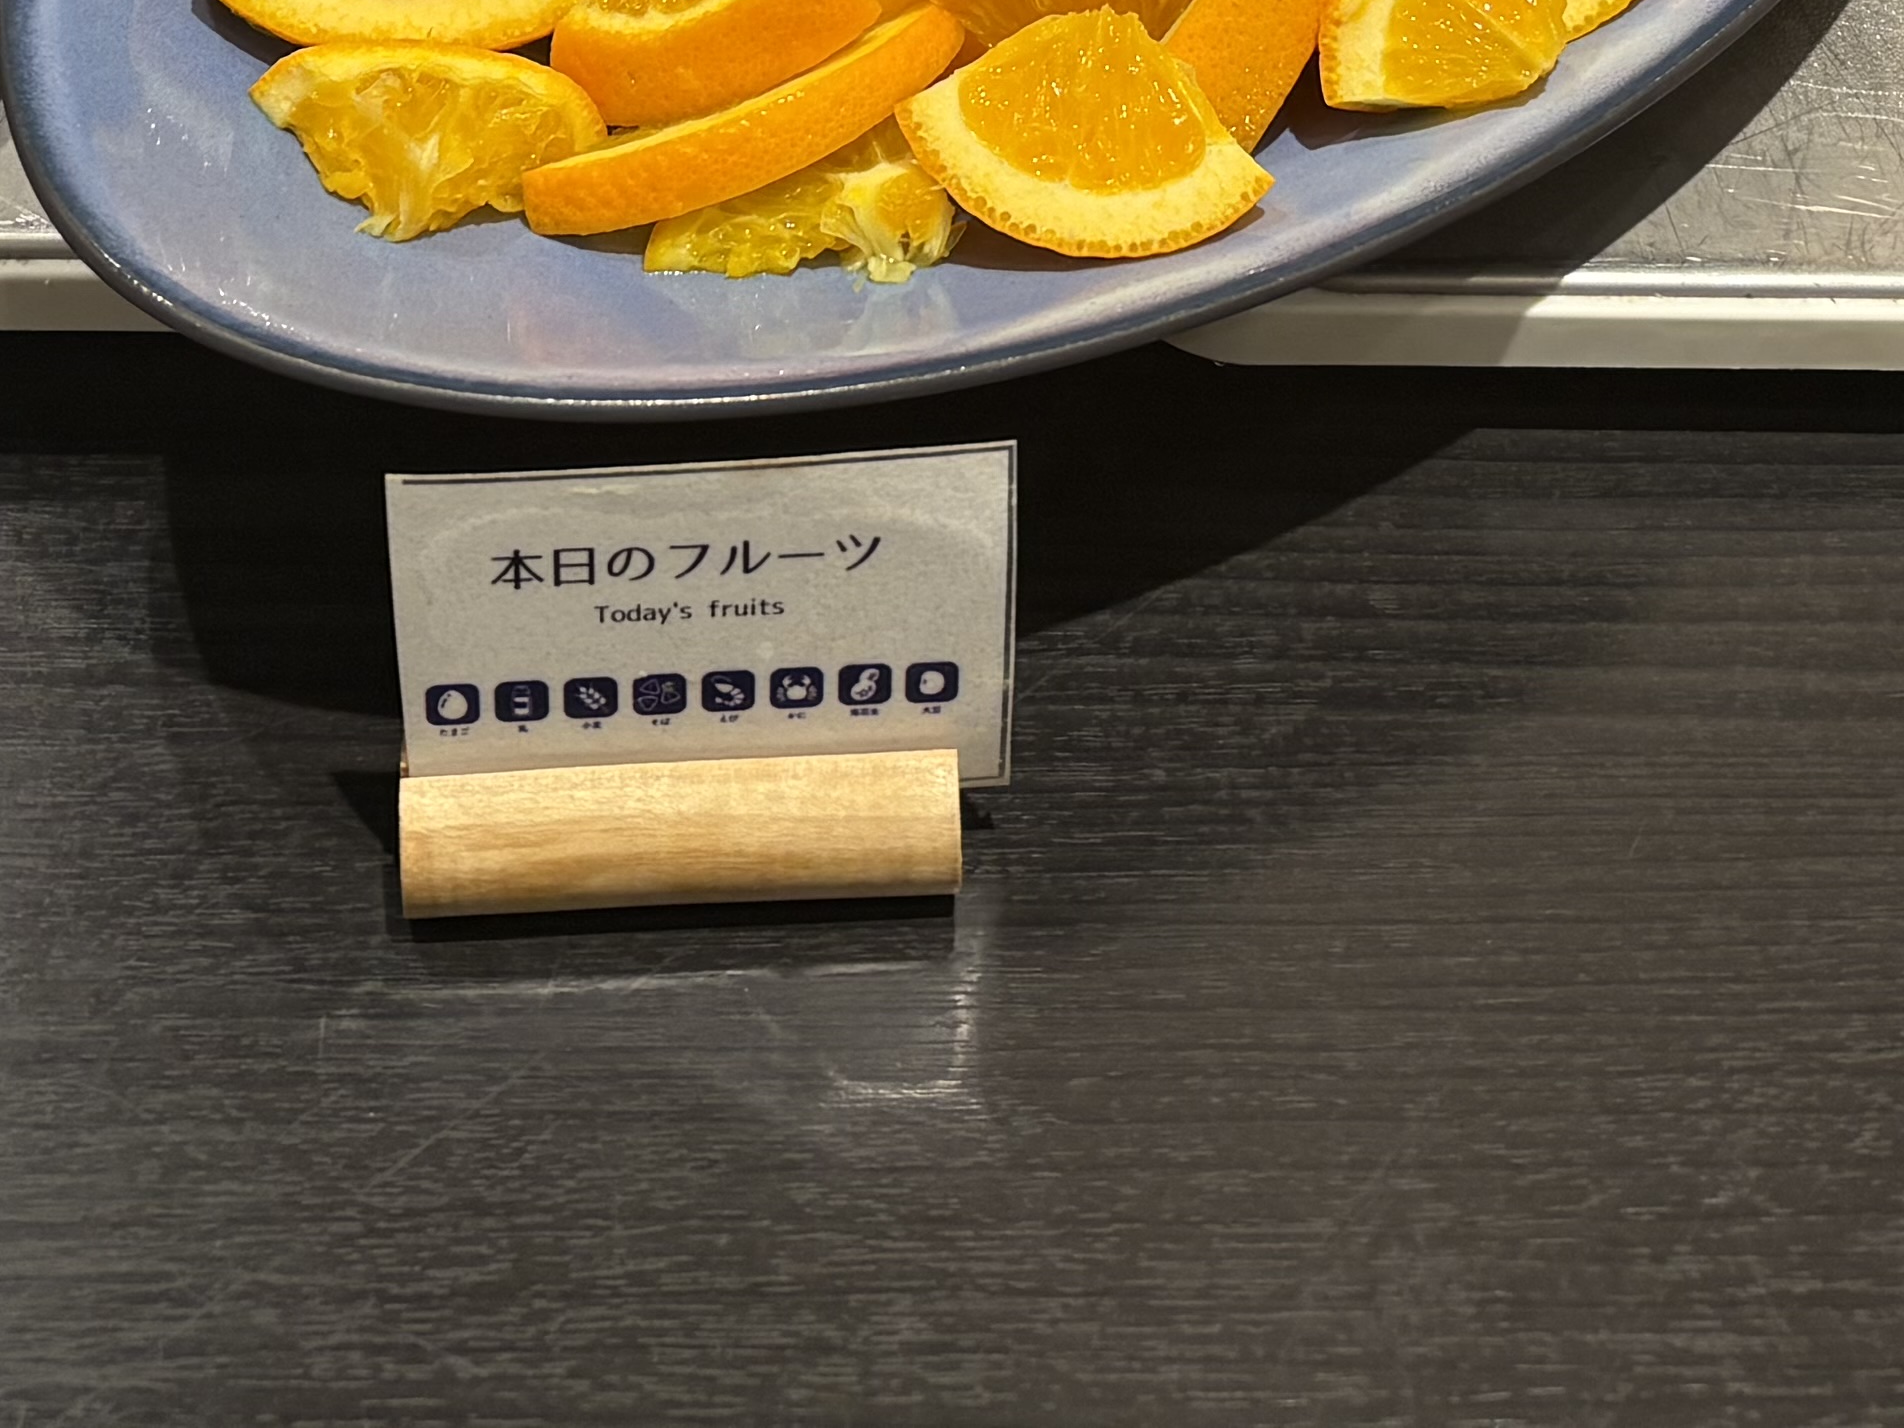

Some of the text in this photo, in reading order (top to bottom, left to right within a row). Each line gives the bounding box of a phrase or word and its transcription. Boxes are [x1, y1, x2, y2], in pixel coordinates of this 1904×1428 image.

[490, 533, 882, 590] 本日のフルーツ
[594, 596, 786, 626] Today's fruits
